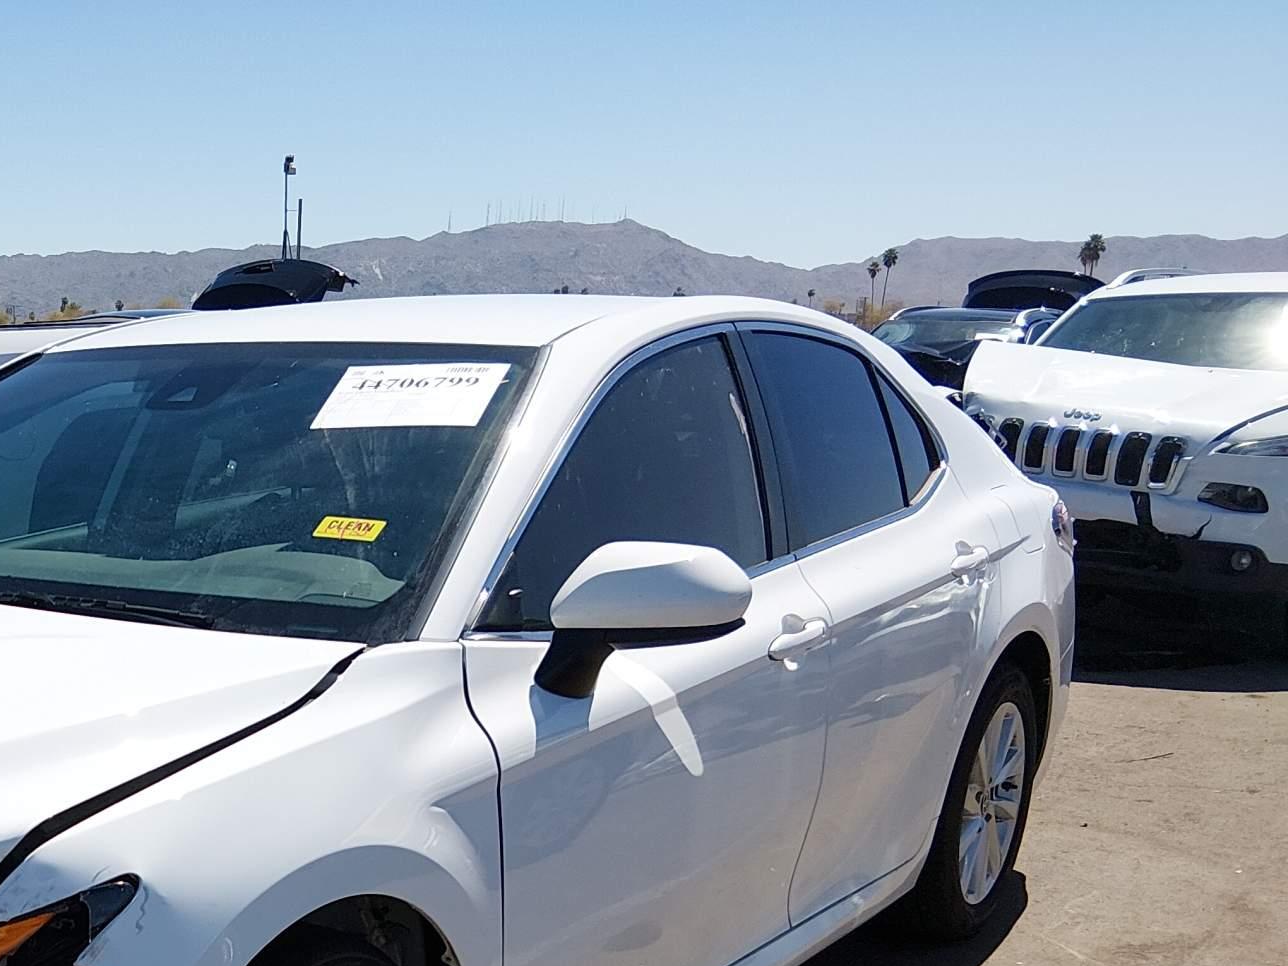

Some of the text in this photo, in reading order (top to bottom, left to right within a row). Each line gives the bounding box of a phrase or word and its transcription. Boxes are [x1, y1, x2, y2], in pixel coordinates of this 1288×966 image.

[352, 376, 480, 391] 44706799
[1063, 408, 1102, 422] Jeep
[326, 519, 376, 533] CLEAN
